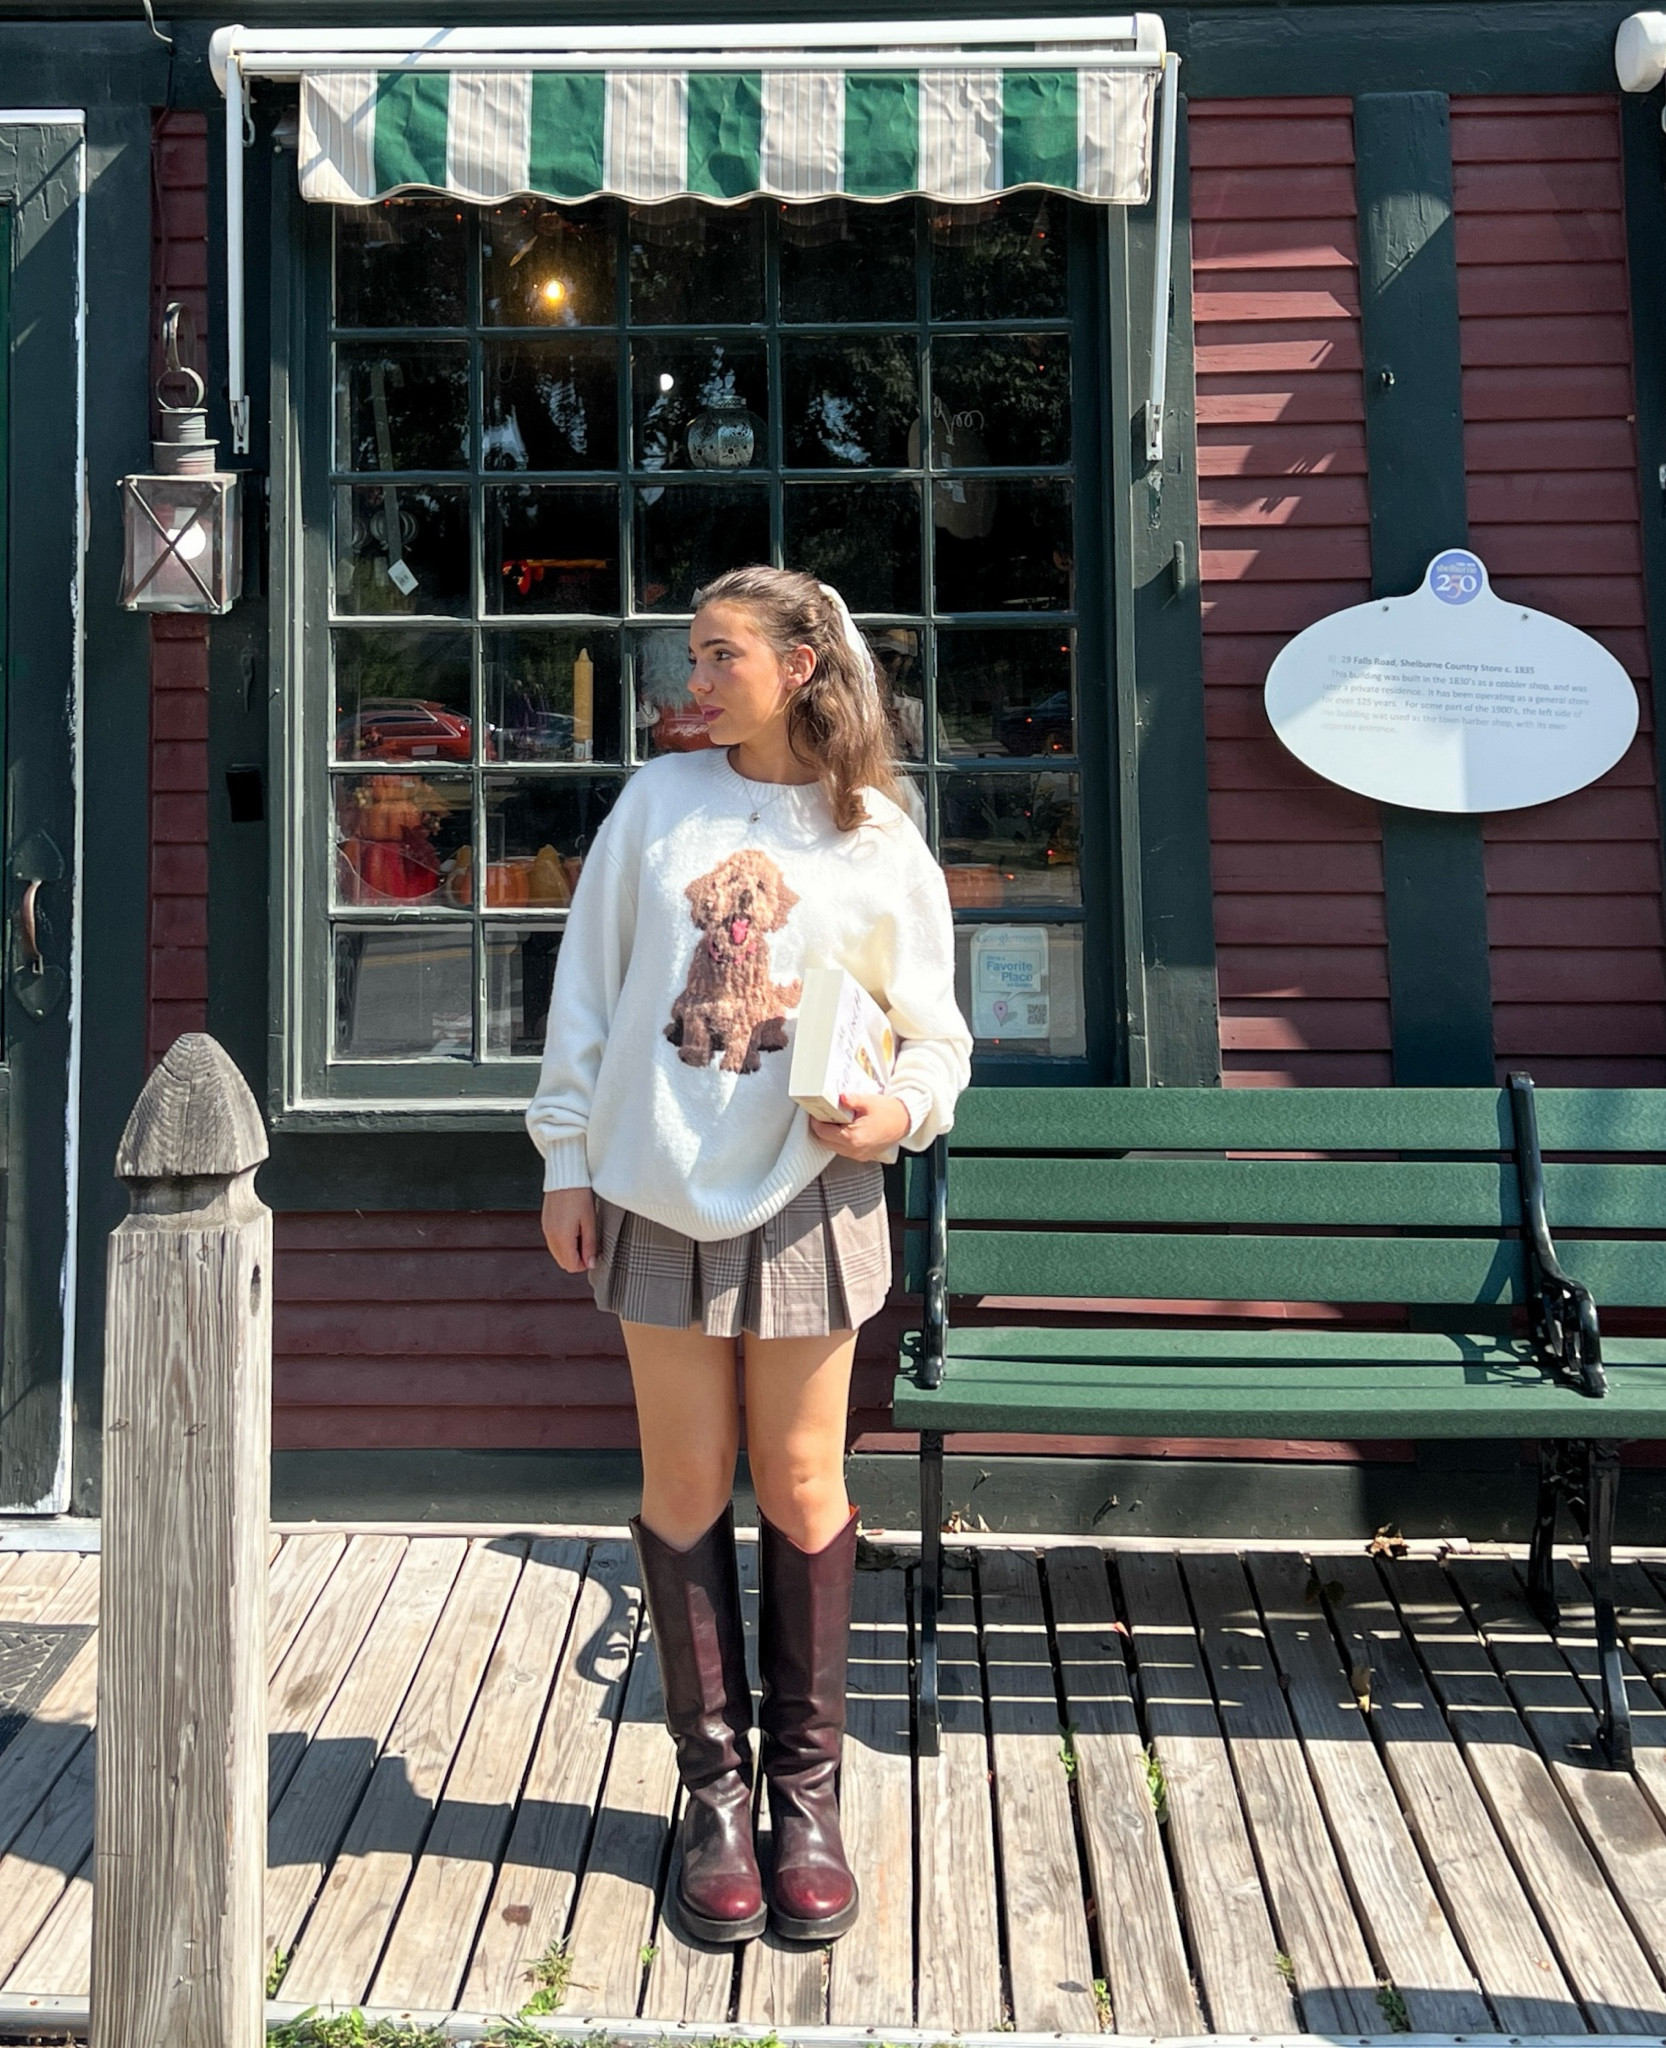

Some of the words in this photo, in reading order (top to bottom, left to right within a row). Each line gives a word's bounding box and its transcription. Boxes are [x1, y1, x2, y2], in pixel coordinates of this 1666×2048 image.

[1436, 574, 1477, 599] 250
[1341, 656, 1352, 664] 29
[1353, 656, 1372, 665] Falls
[1374, 658, 1398, 667] Road,
[1400, 659, 1443, 669] Shelburne
[1445, 662, 1478, 672] Country
[1480, 664, 1503, 672] Store
[1514, 666, 1535, 675] 1835
[1332, 669, 1347, 679] This
[1349, 670, 1382, 682] building
[1402, 674, 1420, 682] built
[1433, 676, 1446, 684] the
[1449, 676, 1475, 686] 1830's
[1495, 680, 1526, 689] cobbler
[1553, 683, 1570, 691] and
[1350, 684, 1380, 693] private
[1436, 689, 1450, 697] has
[1475, 692, 1515, 702] operating
[1535, 696, 1566, 705] general
[1357, 697, 1372, 706] 125
[1444, 703, 1462, 711] part
[1475, 704, 1489, 713] the
[1538, 708, 1552, 716] left
[1554, 709, 1571, 717] side
[1337, 711, 1370, 720] building
[1462, 718, 1489, 726] barber
[986, 961, 1032, 971] Favorite
[1001, 971, 1033, 982] Place
